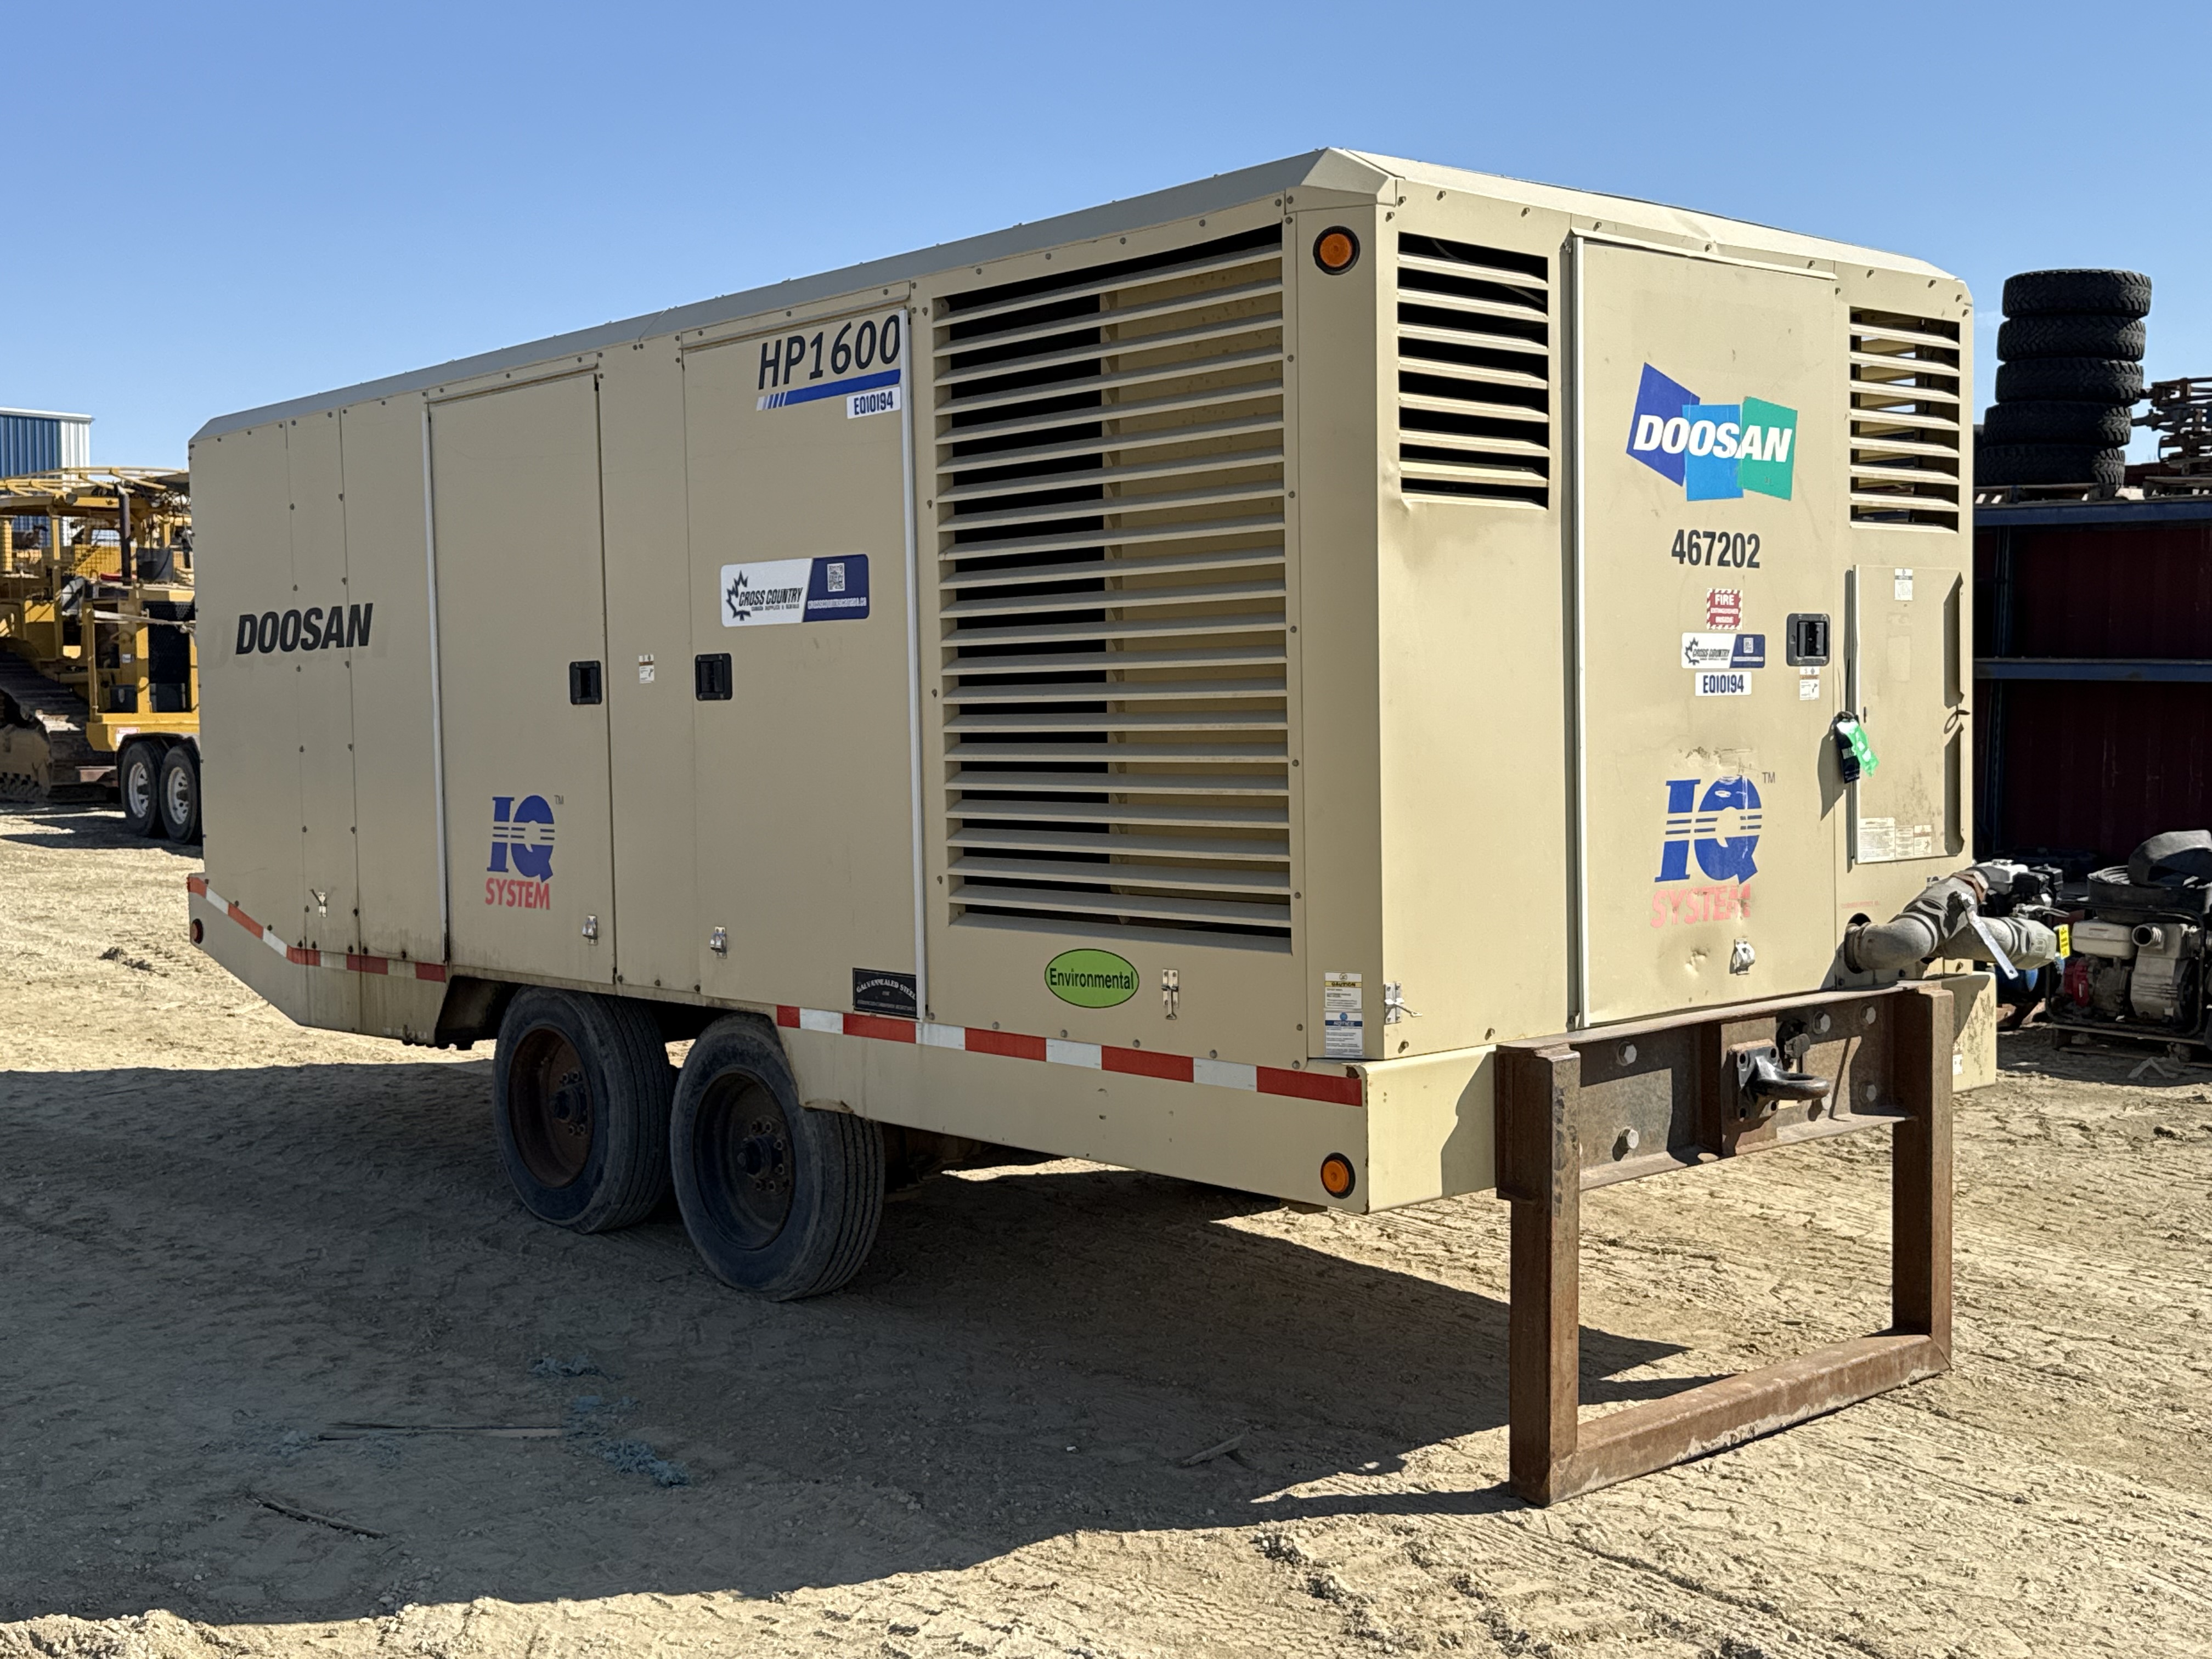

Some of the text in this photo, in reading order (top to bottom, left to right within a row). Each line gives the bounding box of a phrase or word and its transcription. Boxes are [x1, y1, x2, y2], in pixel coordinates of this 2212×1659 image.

[758, 314, 900, 390] HP1600
[1633, 415, 1792, 462] DOOSAN
[1671, 529, 1760, 568] 467202
[739, 590, 765, 606] CROSS
[766, 587, 803, 604] COUNTRY
[1715, 594, 1734, 605] FIRE
[235, 603, 373, 654] DOOSAN
[487, 795, 555, 883] IQ
[1655, 774, 1762, 884] IQ
[485, 877, 550, 910] SYSTEM
[1650, 884, 1751, 928] SYSTEM
[900, 984, 916, 1000] STEEL
[1049, 968, 1134, 989] Environmental
